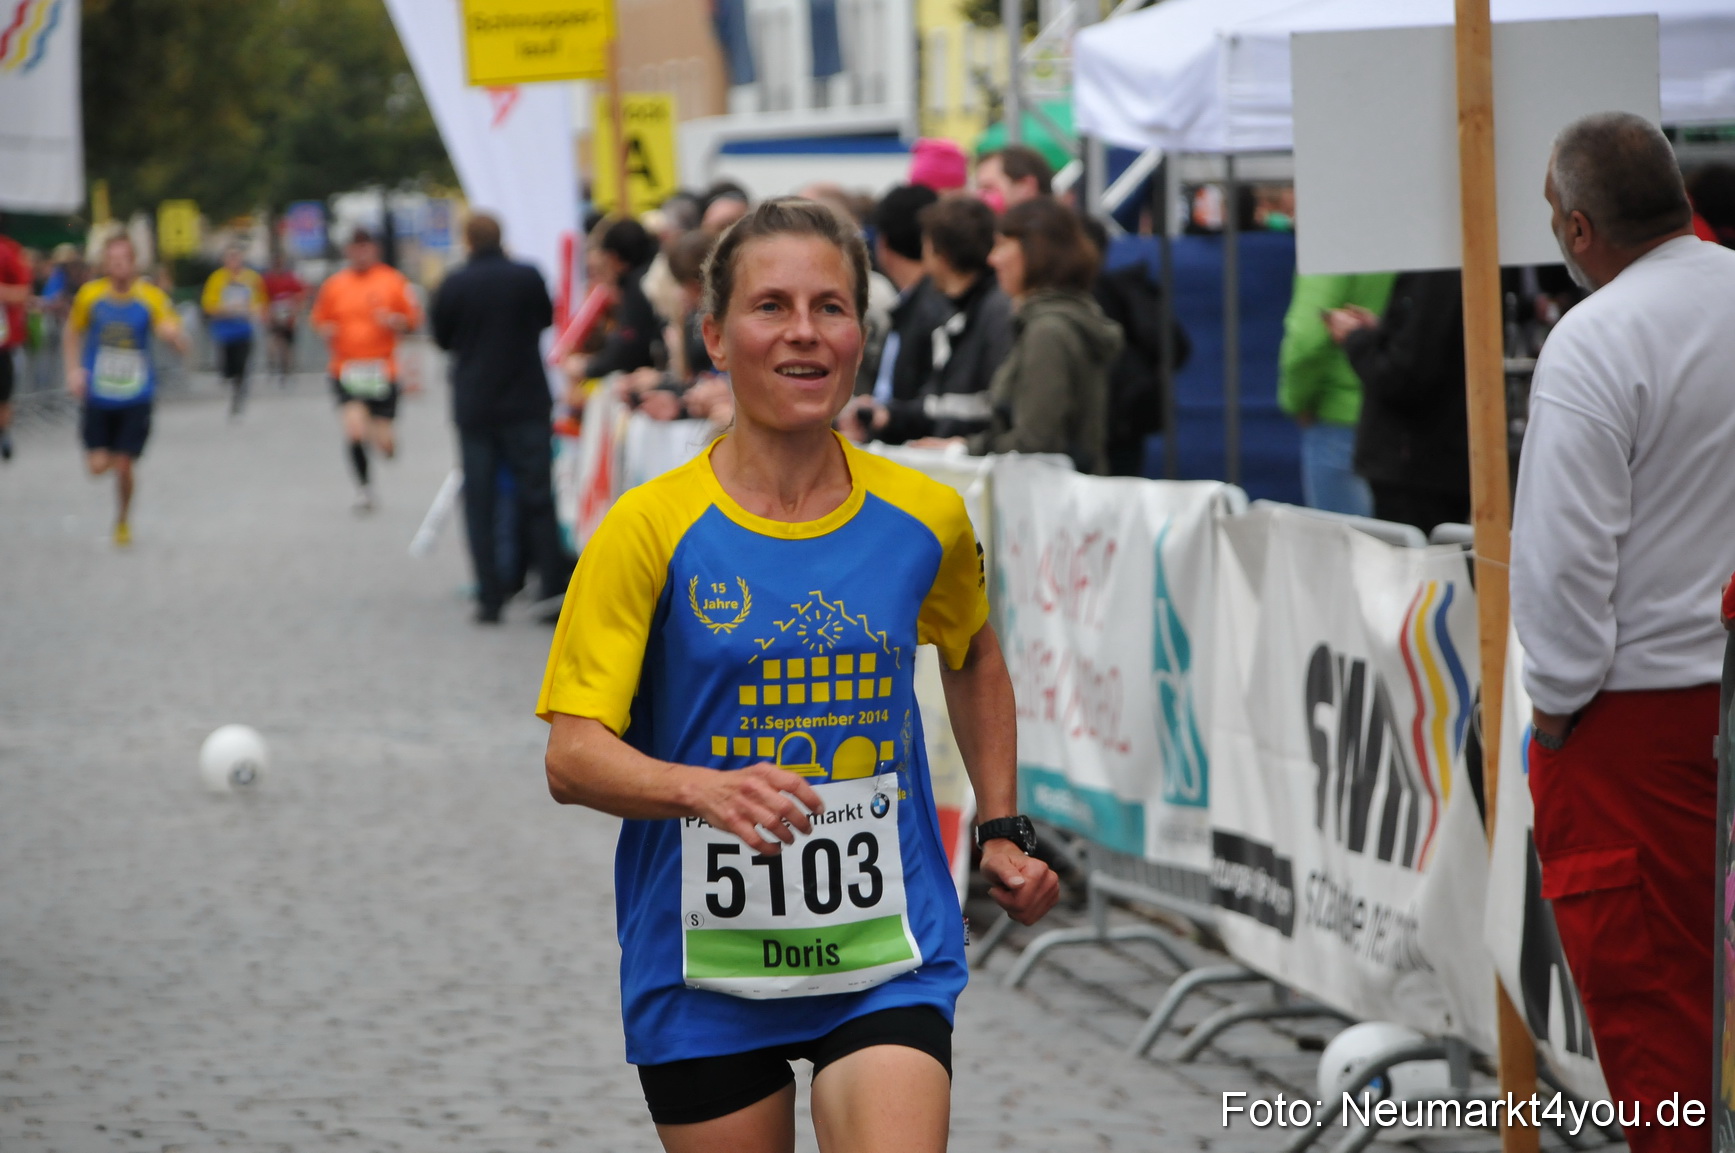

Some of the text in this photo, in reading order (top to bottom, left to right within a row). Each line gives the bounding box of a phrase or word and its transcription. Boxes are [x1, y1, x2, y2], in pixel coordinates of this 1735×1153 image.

[711, 583, 727, 594] 15
[703, 599, 739, 610] Jahre
[739, 709, 889, 732] 21.September 2014
[705, 831, 884, 919] 5103
[690, 913, 700, 927] S
[762, 938, 841, 969] Doris
